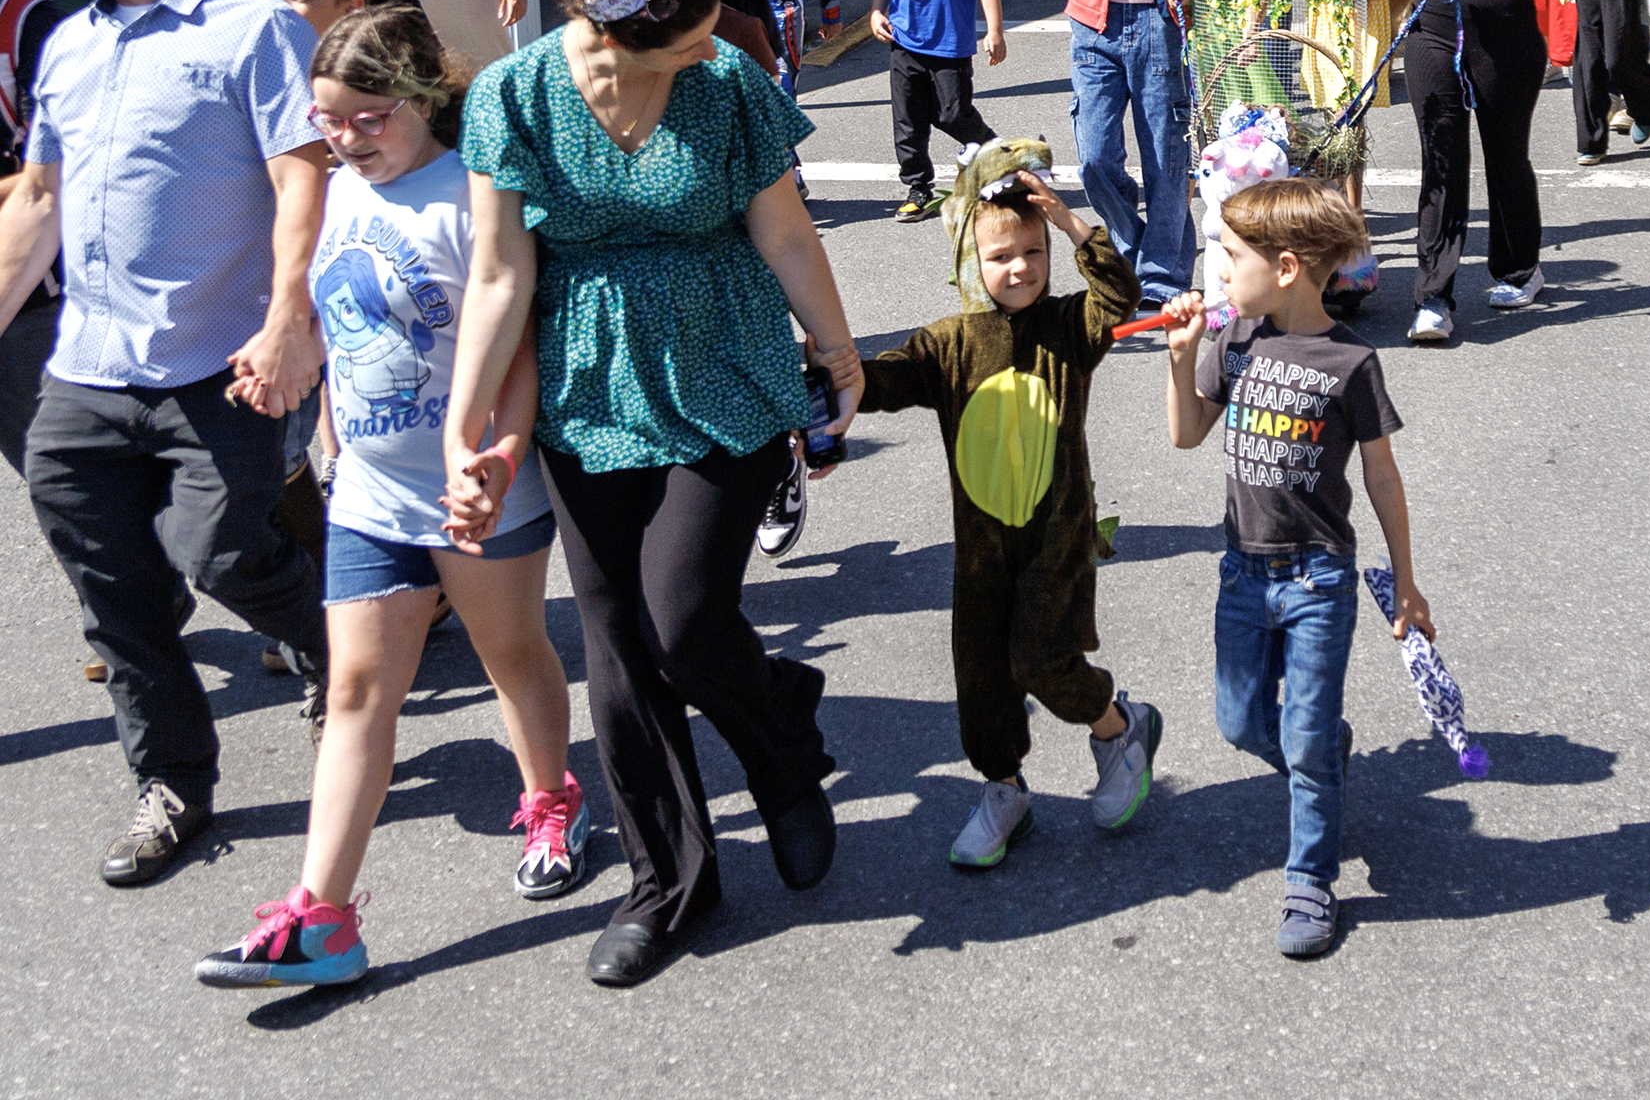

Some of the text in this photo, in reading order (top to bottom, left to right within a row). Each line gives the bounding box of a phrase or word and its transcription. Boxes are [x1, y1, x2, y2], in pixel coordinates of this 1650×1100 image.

[341, 215, 359, 246] A
[362, 214, 455, 330] BUMMER
[1225, 351, 1339, 396] BE HAPPY
[1244, 380, 1331, 418] HAPPY
[1242, 406, 1326, 443] HAPPY
[1239, 433, 1324, 468] HAPPY
[1238, 459, 1321, 493] HAPPY
